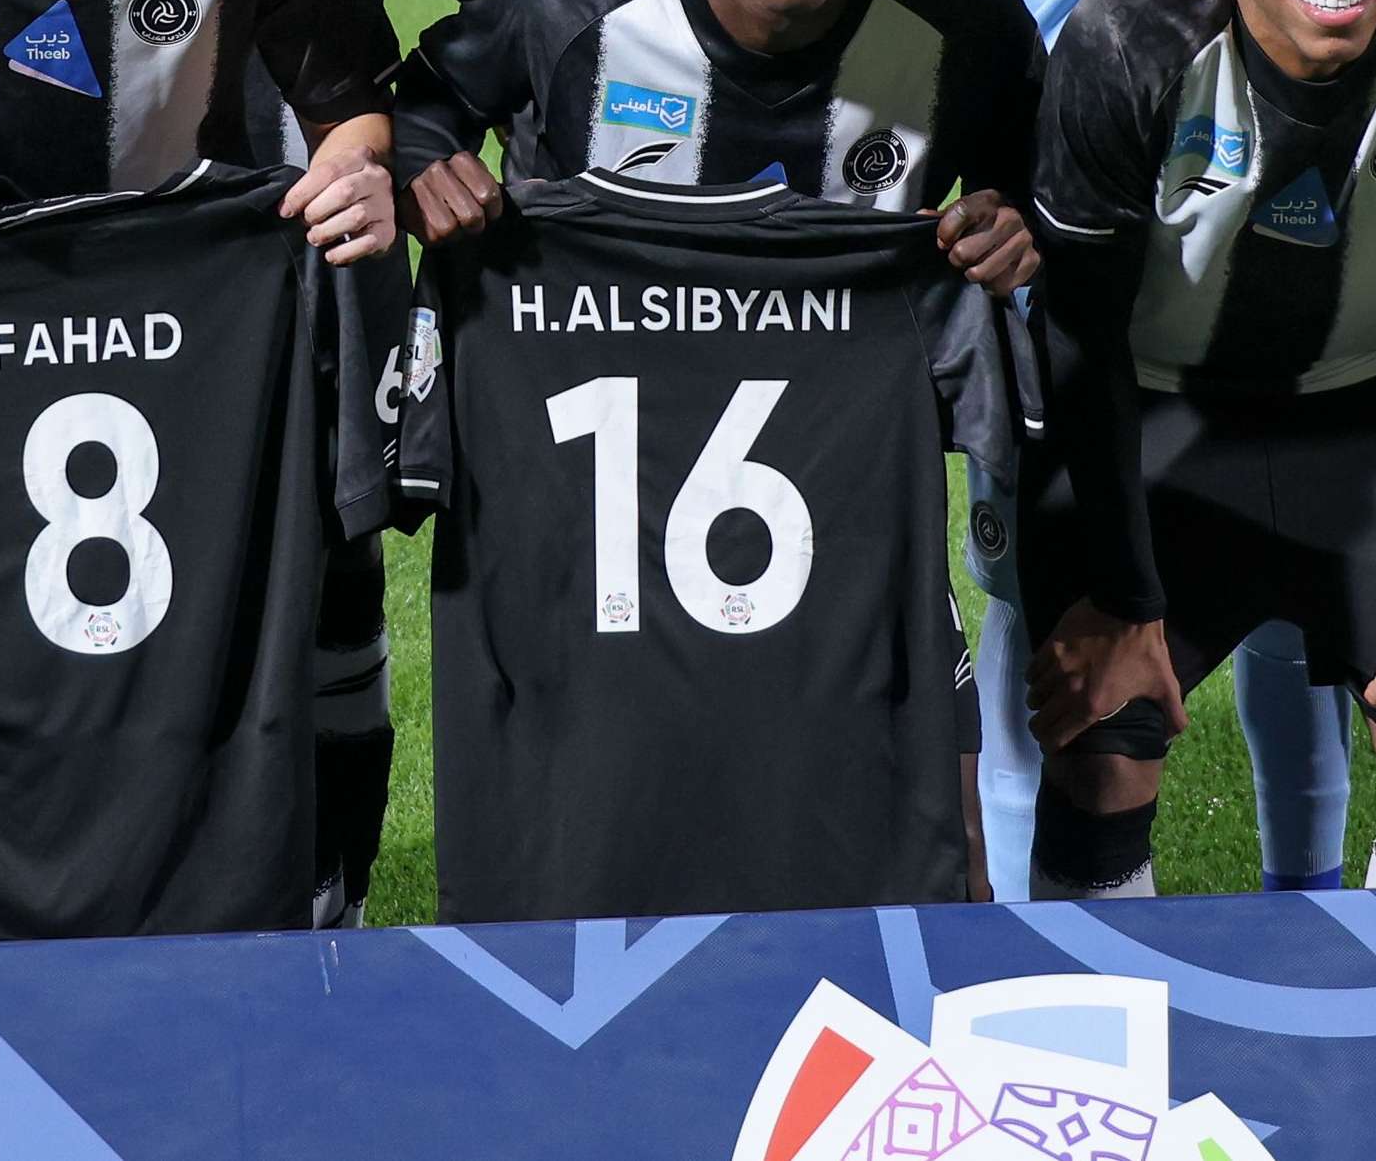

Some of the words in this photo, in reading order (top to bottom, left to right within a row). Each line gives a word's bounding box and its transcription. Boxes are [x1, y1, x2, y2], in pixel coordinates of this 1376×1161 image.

[25, 30, 70, 47] ذيب
[26, 46, 70, 60] Theeb
[1271, 212, 1317, 225] Theeb
[512, 285, 851, 332] H.ALSIBYANI
[545, 376, 814, 634] 16
[22, 391, 174, 655] 8
[96, 625, 110, 633] RSL
